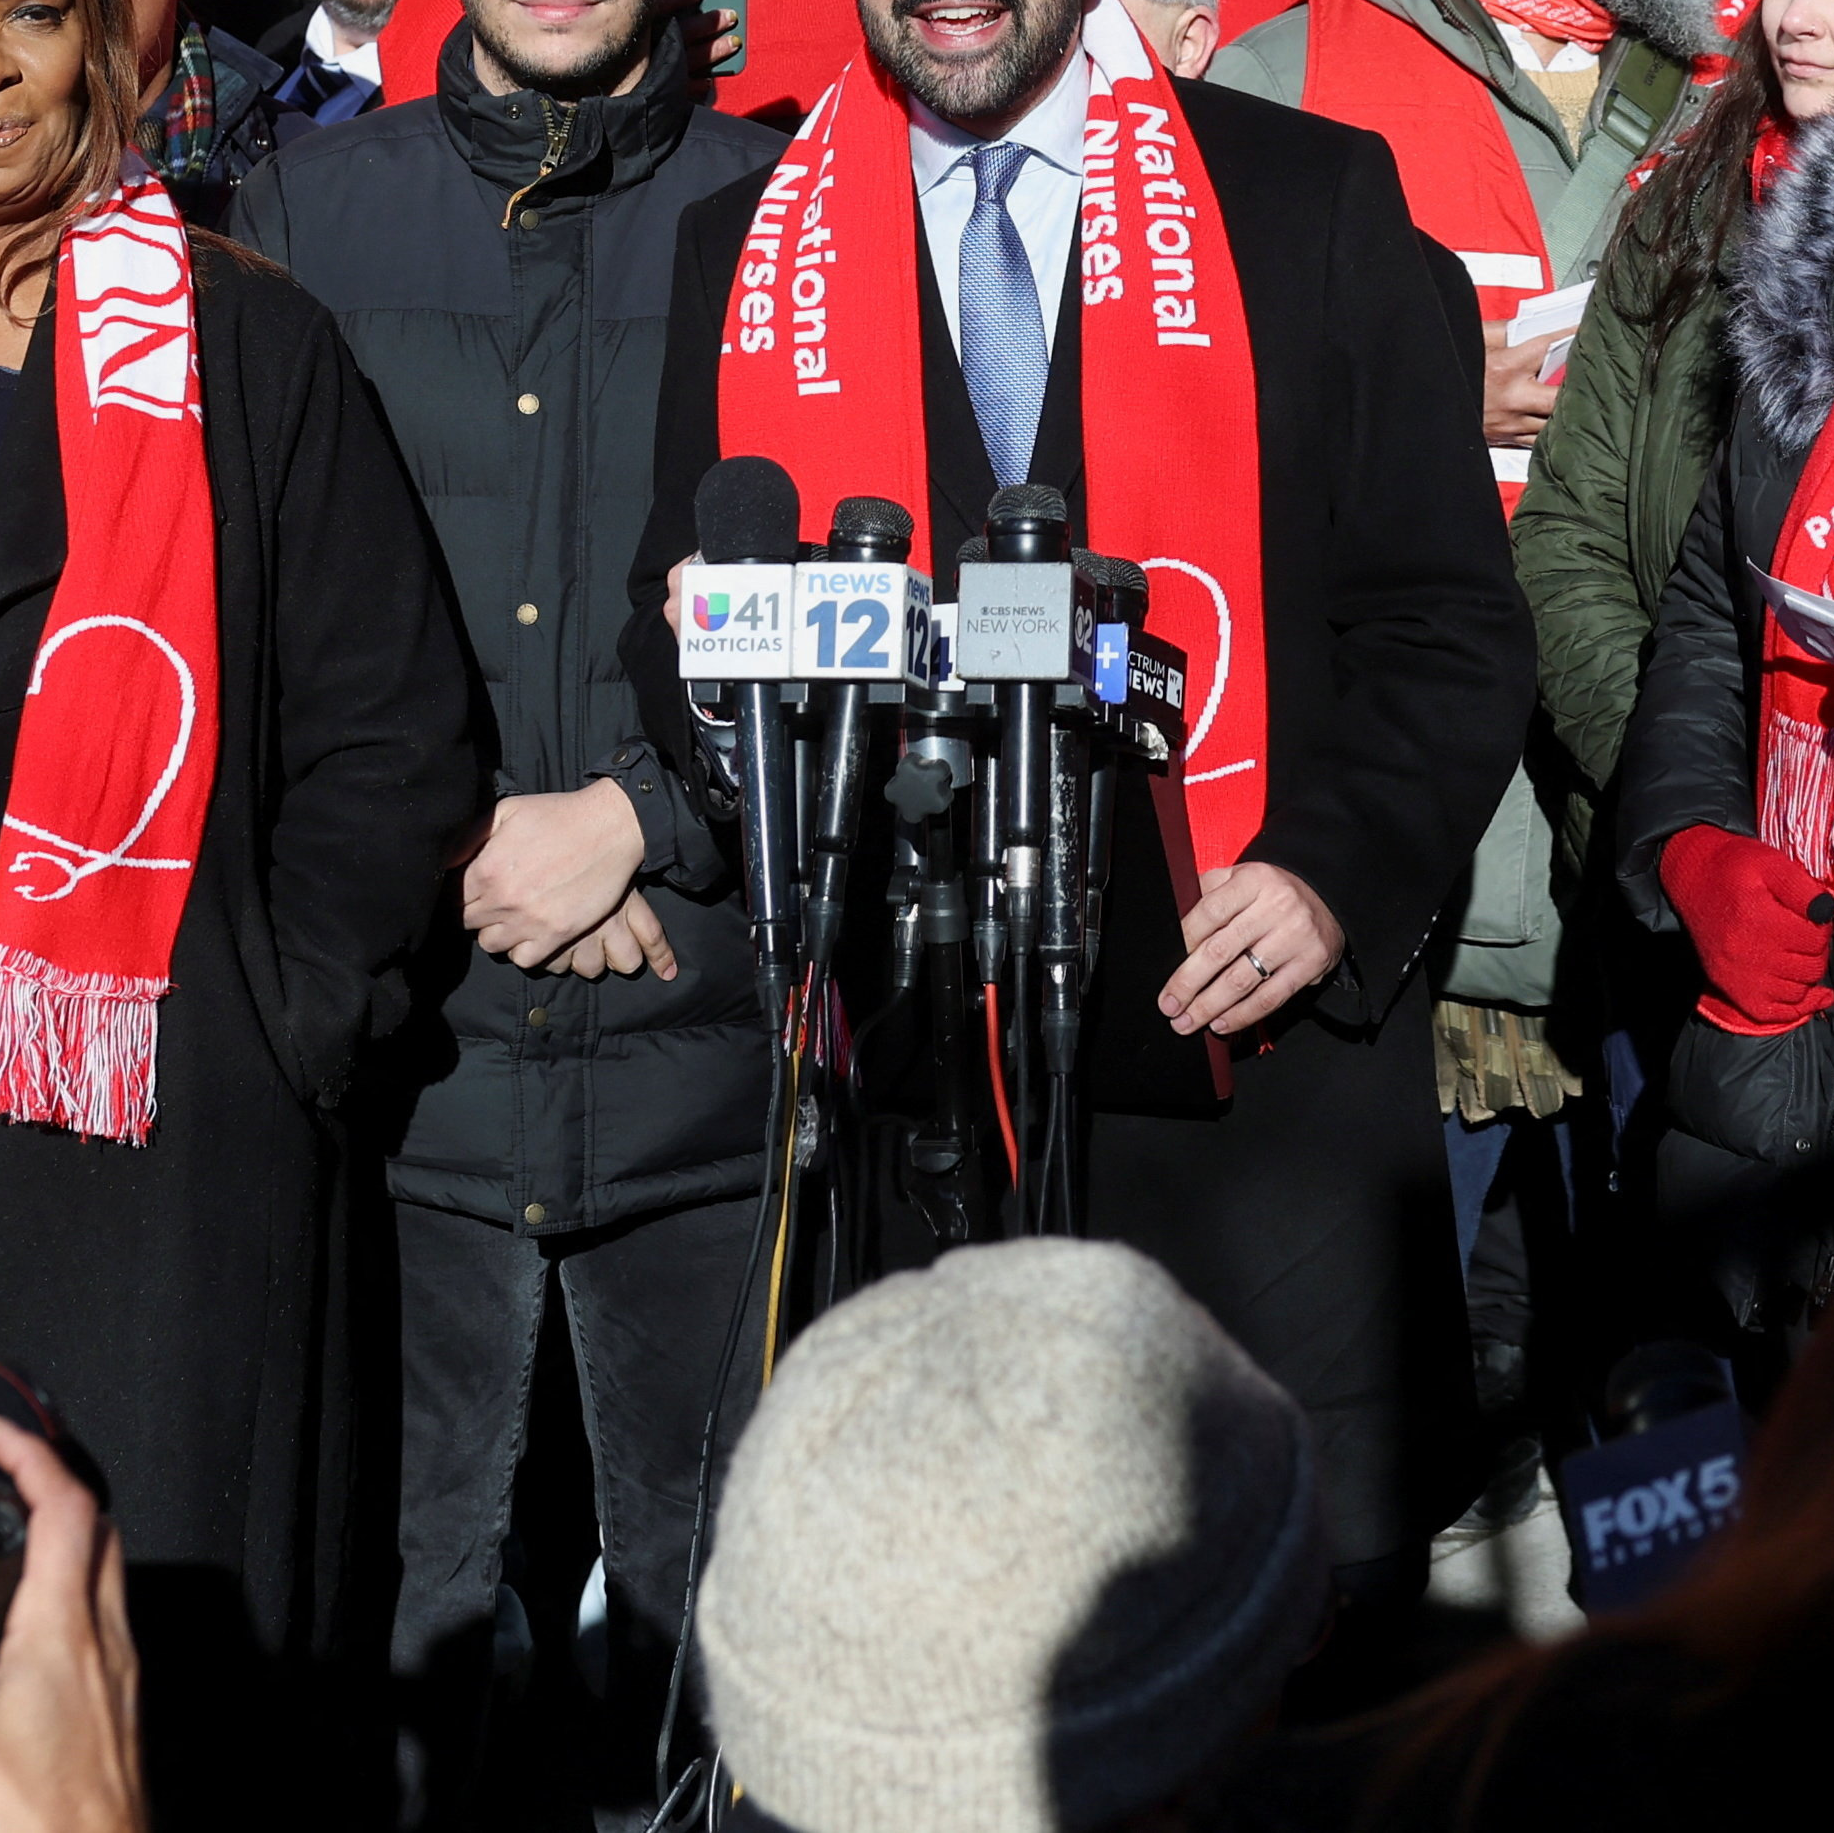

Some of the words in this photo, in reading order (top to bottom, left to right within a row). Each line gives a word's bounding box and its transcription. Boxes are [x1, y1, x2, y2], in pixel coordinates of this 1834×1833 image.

[1081, 118, 1124, 306] Nurses
[1127, 101, 1212, 348] National
[738, 163, 809, 355] Nurses
[807, 572, 892, 594] news
[907, 576, 930, 607] news
[733, 592, 780, 632] 41
[967, 619, 1009, 634] NEW
[1010, 619, 1060, 634] YORK
[989, 606, 1011, 616] CBS
[1012, 606, 1046, 616] NEWS
[686, 637, 783, 653] NOTICIAS
[806, 598, 891, 669] 12
[906, 604, 929, 682] 12
[1127, 650, 1166, 678] CTRUM
[1582, 1469, 1698, 1553] FOX
[1698, 1453, 1740, 1509] 5
